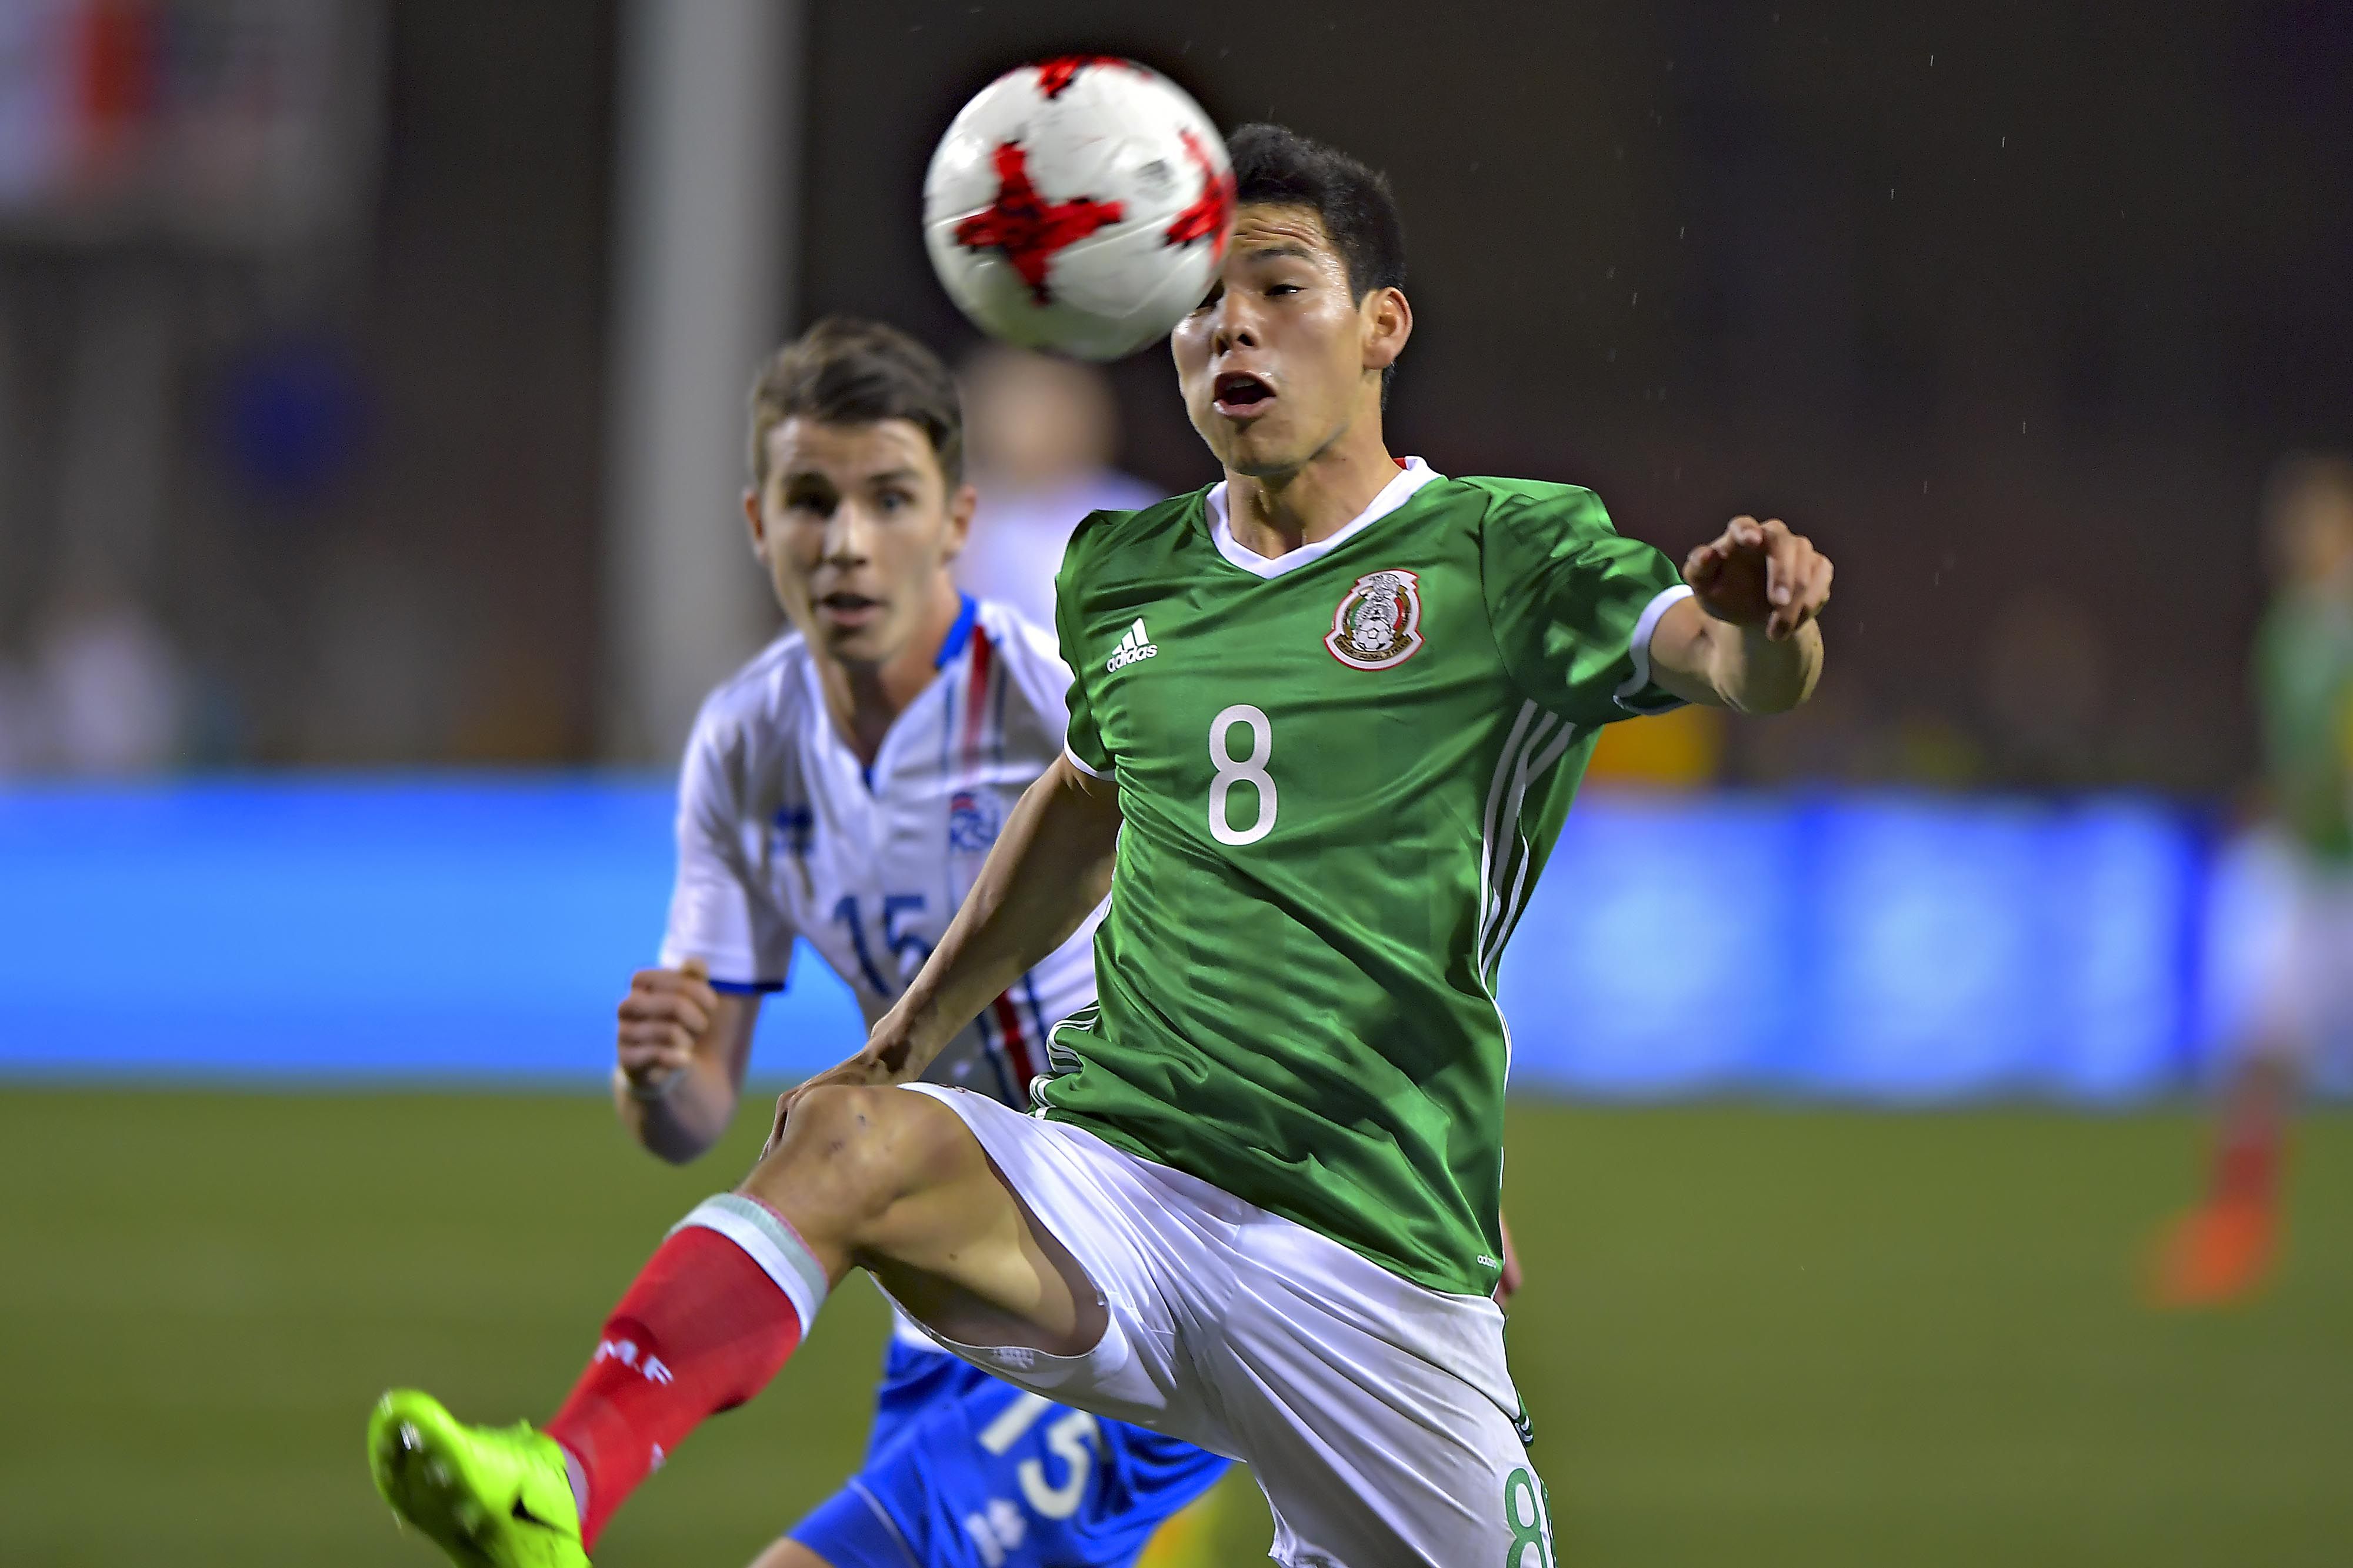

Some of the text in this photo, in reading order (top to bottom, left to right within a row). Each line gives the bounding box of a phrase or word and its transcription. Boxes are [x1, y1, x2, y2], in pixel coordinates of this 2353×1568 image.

[1106, 645, 1158, 673] adidas
[1209, 704, 1277, 846] 8
[1505, 1468, 1548, 1568] 8
